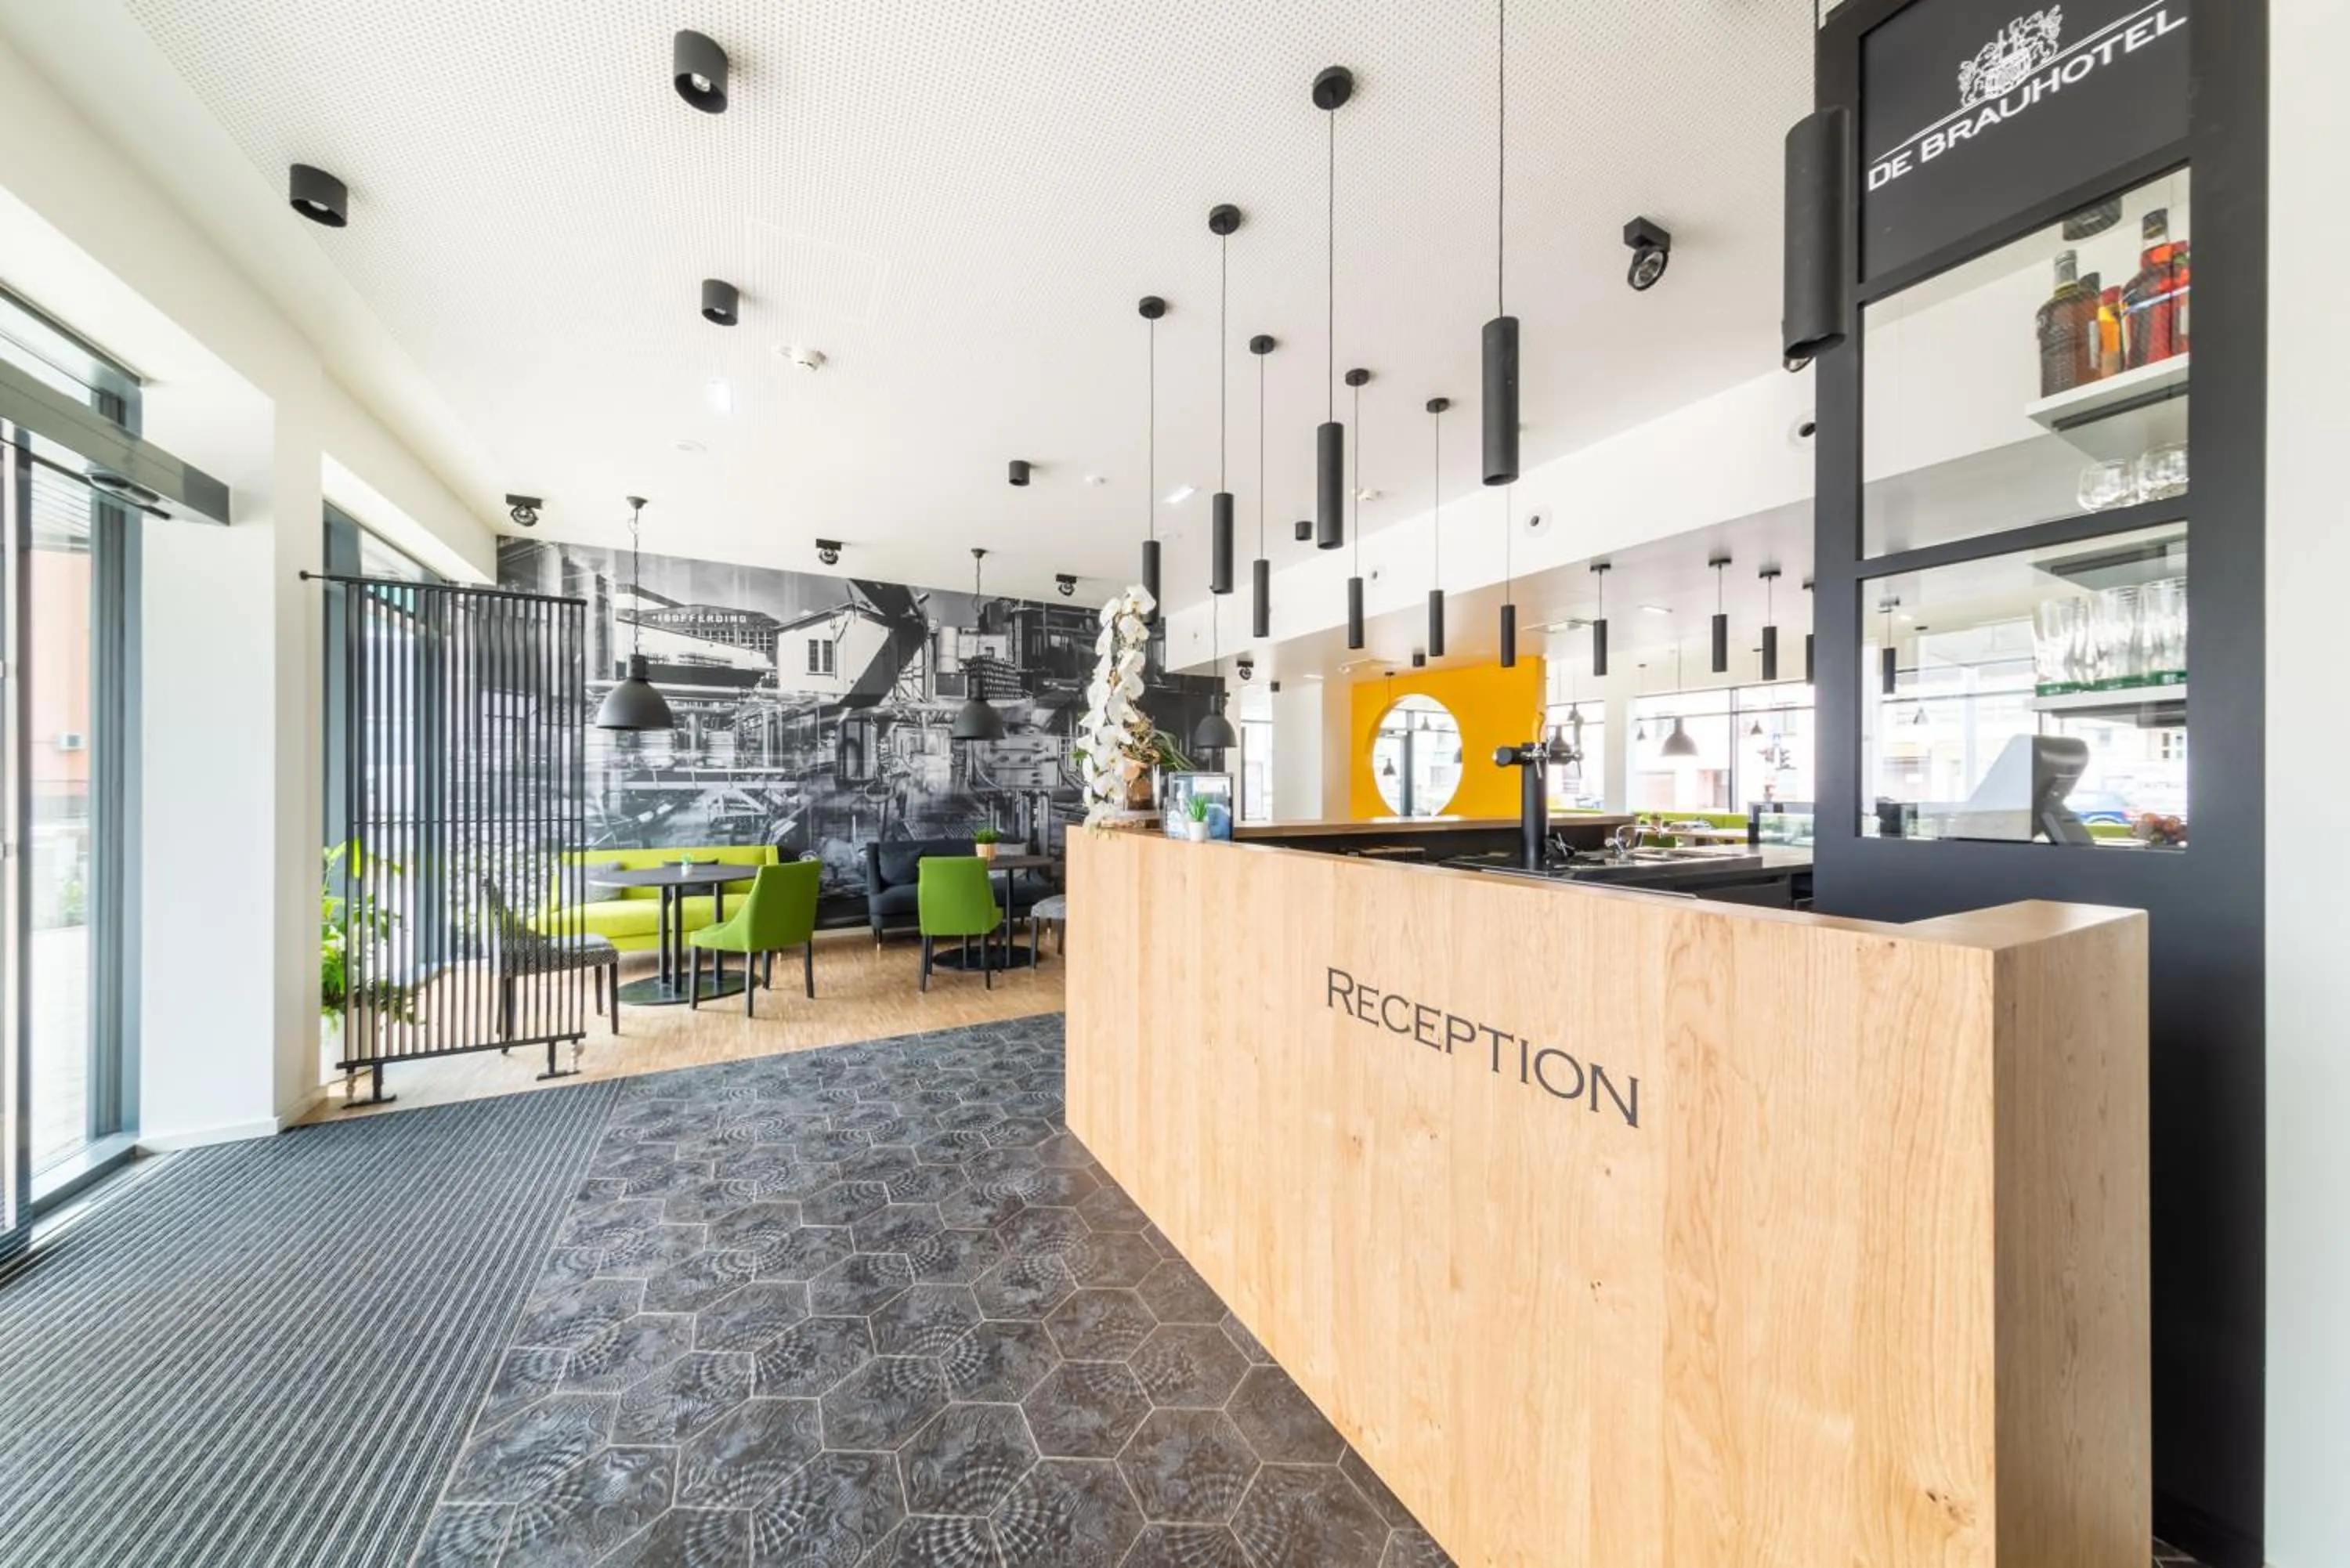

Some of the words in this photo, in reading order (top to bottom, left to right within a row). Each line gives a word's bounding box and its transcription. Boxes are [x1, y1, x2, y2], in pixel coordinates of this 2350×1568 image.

[1868, 150, 1913, 192] DE
[1921, 9, 2187, 163] BRAUHOTEL
[1327, 966, 1640, 1129] RECEPTION
